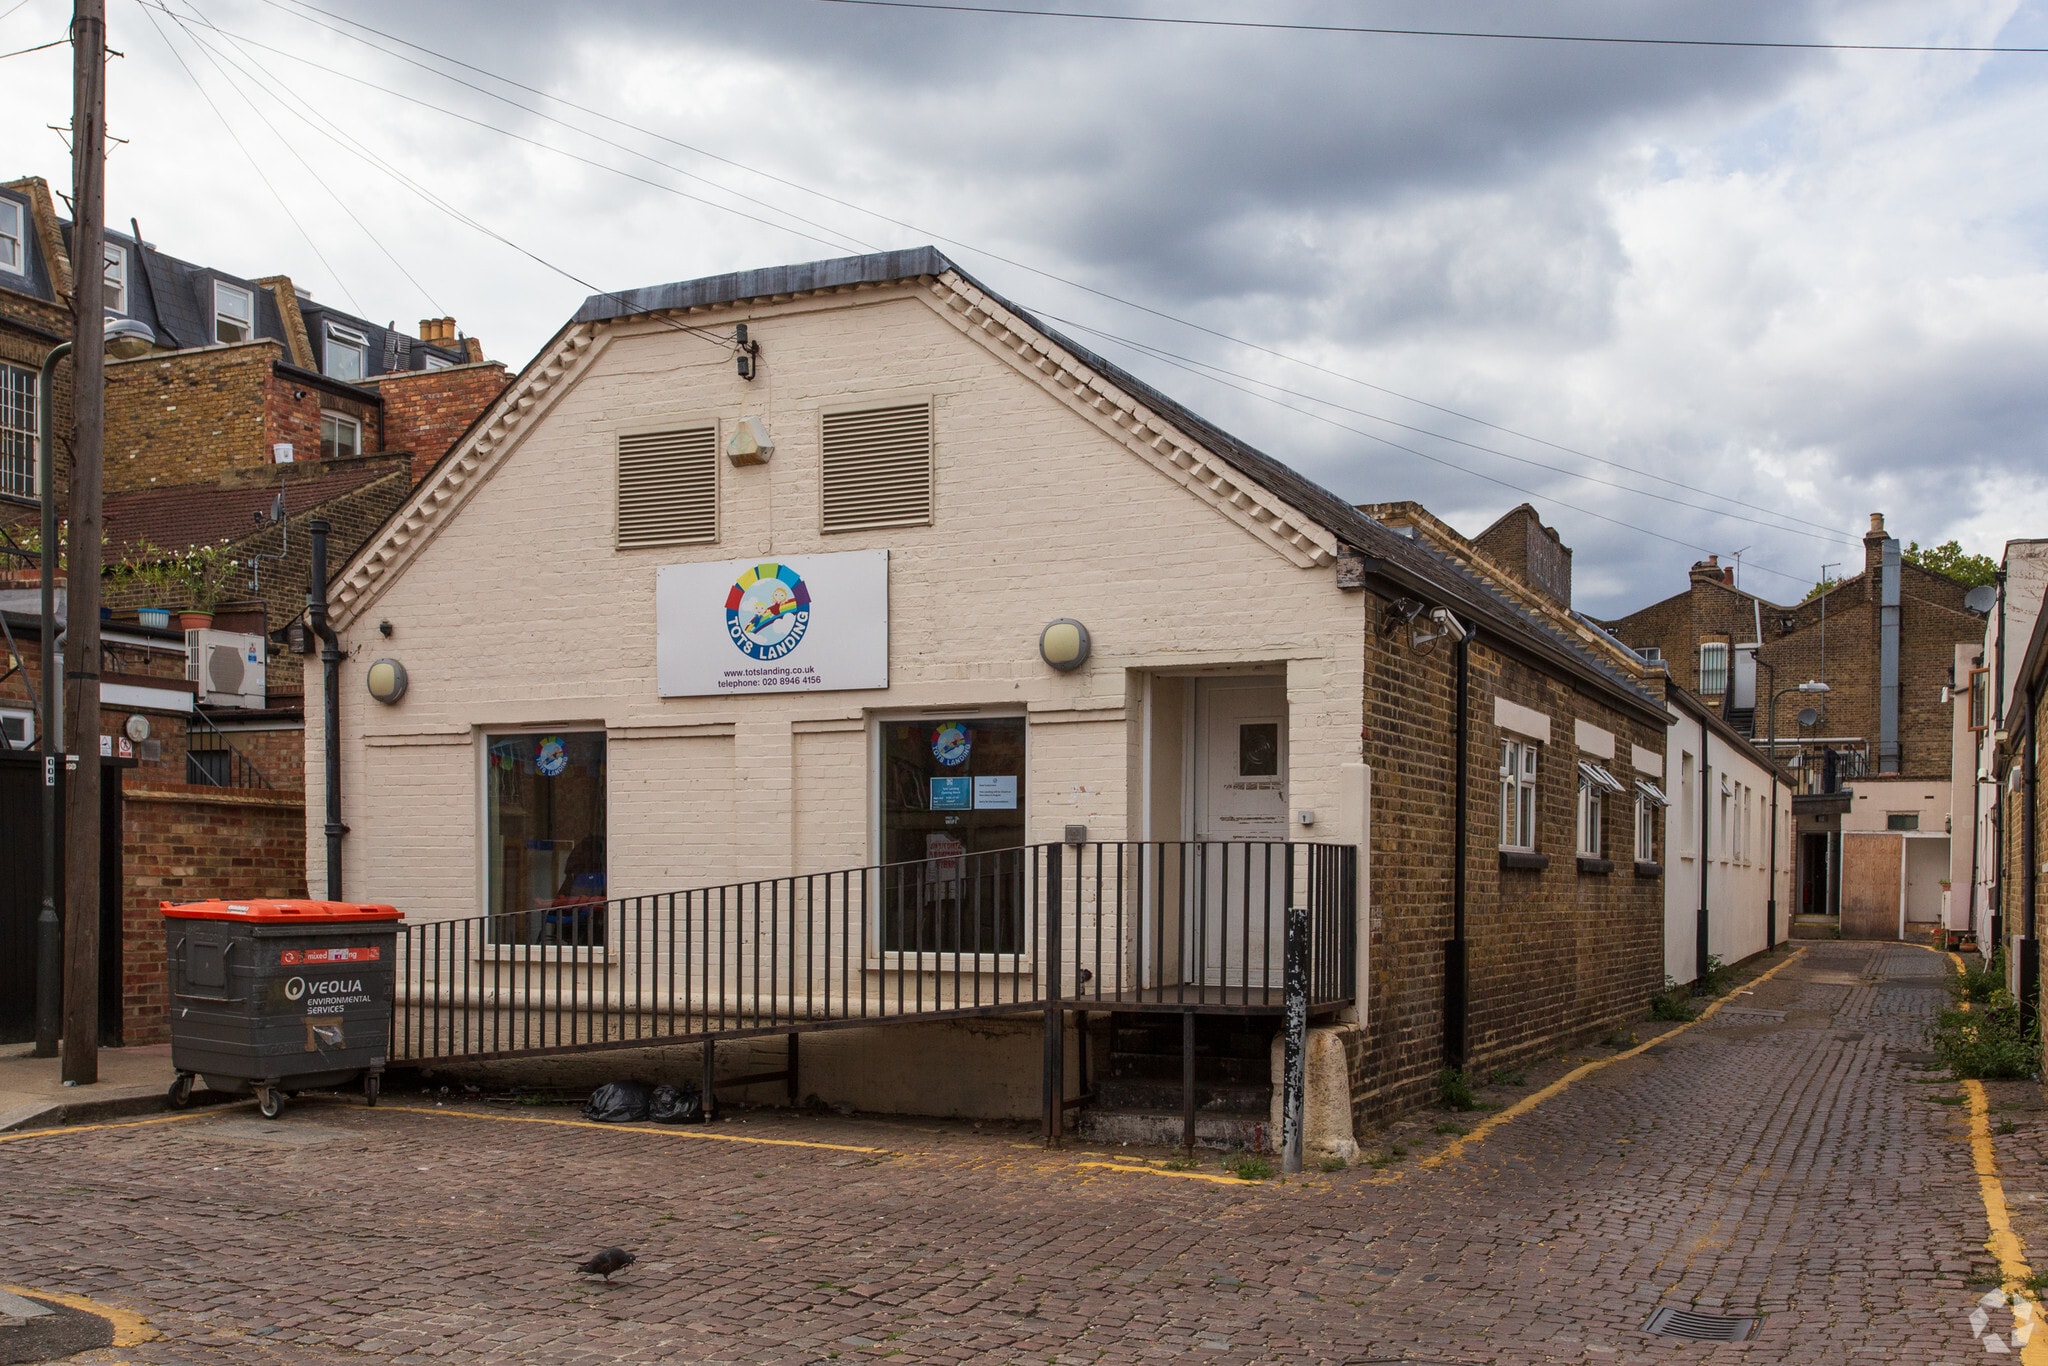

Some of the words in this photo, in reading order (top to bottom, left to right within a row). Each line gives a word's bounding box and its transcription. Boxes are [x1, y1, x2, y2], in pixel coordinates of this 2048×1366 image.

[728, 616, 753, 654] TOTS
[759, 611, 809, 660] LANDING
[724, 666, 815, 677] www.totslanding.co.uk
[718, 680, 760, 689] telephone:
[762, 677, 778, 686] 020
[779, 677, 800, 686] 8946
[802, 676, 821, 684] 4156
[947, 744, 971, 766] LANDING
[307, 951, 328, 960] mixed
[308, 979, 362, 995] VEOLIA
[307, 995, 371, 1006] ENVIRONMENTAL
[307, 1004, 345, 1015] SERVICES
